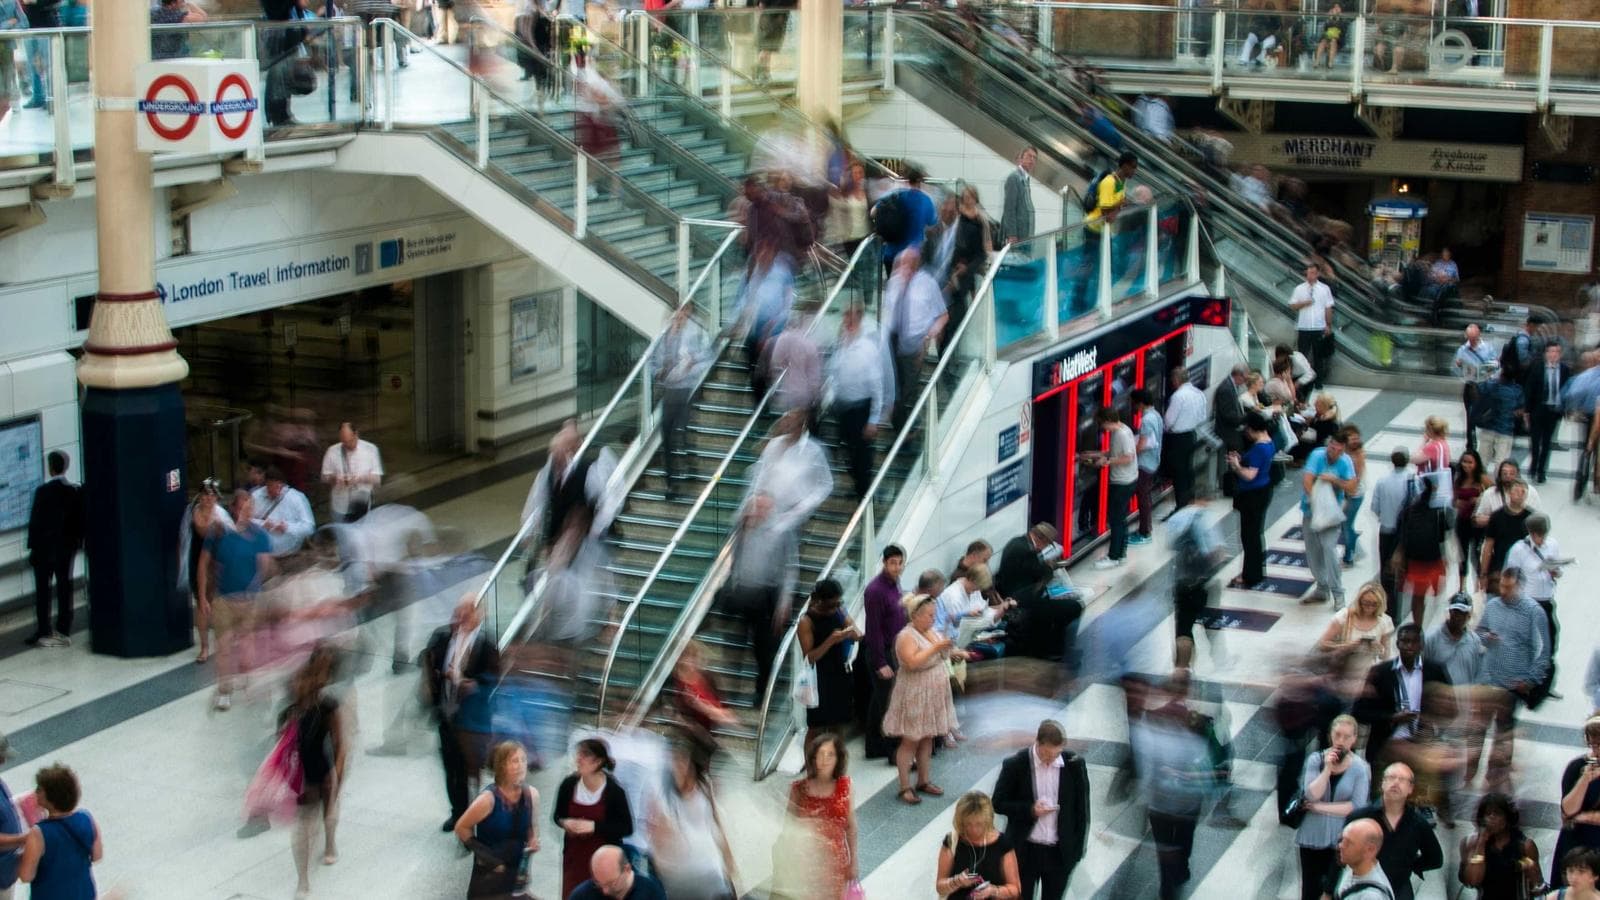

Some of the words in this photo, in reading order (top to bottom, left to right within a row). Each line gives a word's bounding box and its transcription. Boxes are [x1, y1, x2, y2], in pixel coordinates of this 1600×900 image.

[142, 101, 203, 111] UNDERGROUND
[213, 99, 256, 111] UNDERGROUND
[1284, 137, 1375, 158] MERCHANT
[1296, 154, 1361, 167] BISHOPSGATE
[172, 277, 224, 303] London
[230, 267, 271, 289] Travel
[277, 254, 350, 282] Information
[1062, 345, 1097, 384] NatWest
